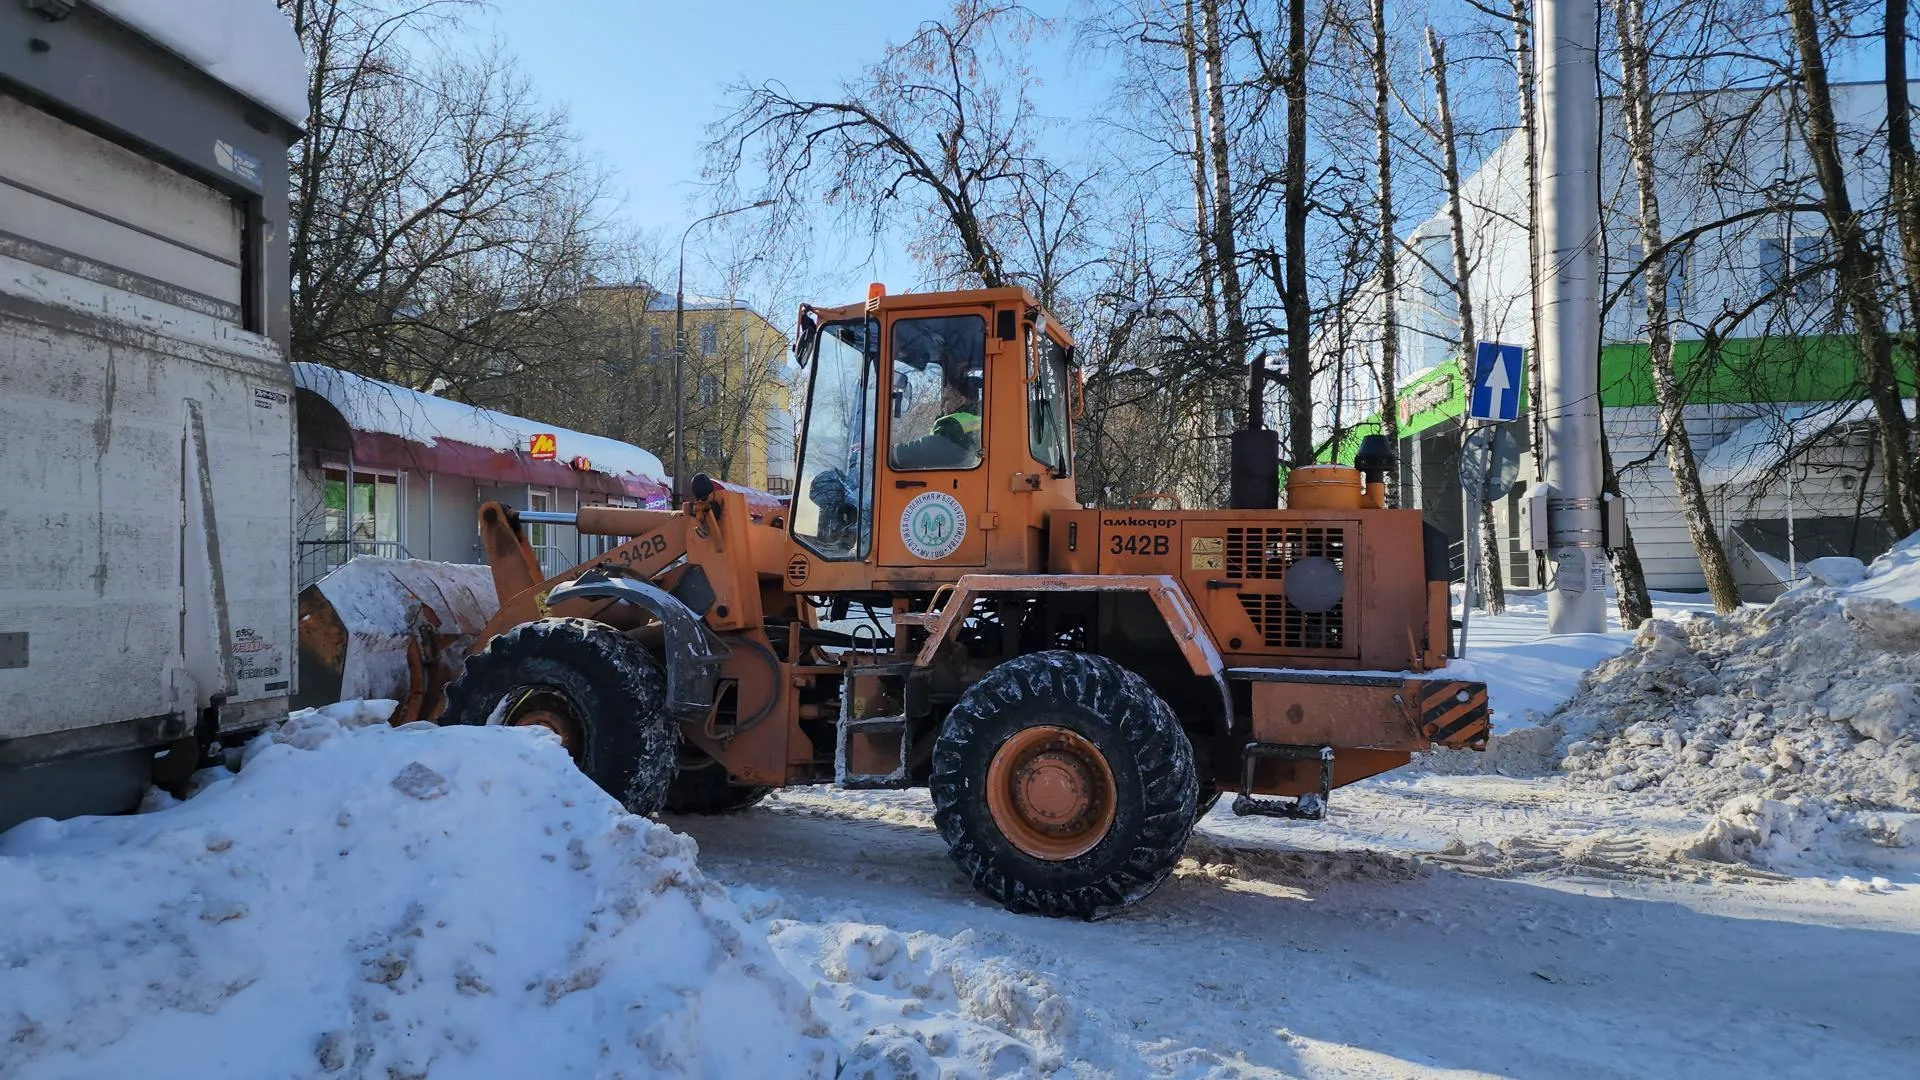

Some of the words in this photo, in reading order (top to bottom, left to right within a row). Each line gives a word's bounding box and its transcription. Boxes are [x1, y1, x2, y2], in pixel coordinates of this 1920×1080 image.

[903, 493, 935, 522] ОЗЕЛЕНЕНИЯ
[941, 494, 965, 550] БЛАГОУСТРОЙСТВА
[902, 524, 918, 551] СЛУЖБА
